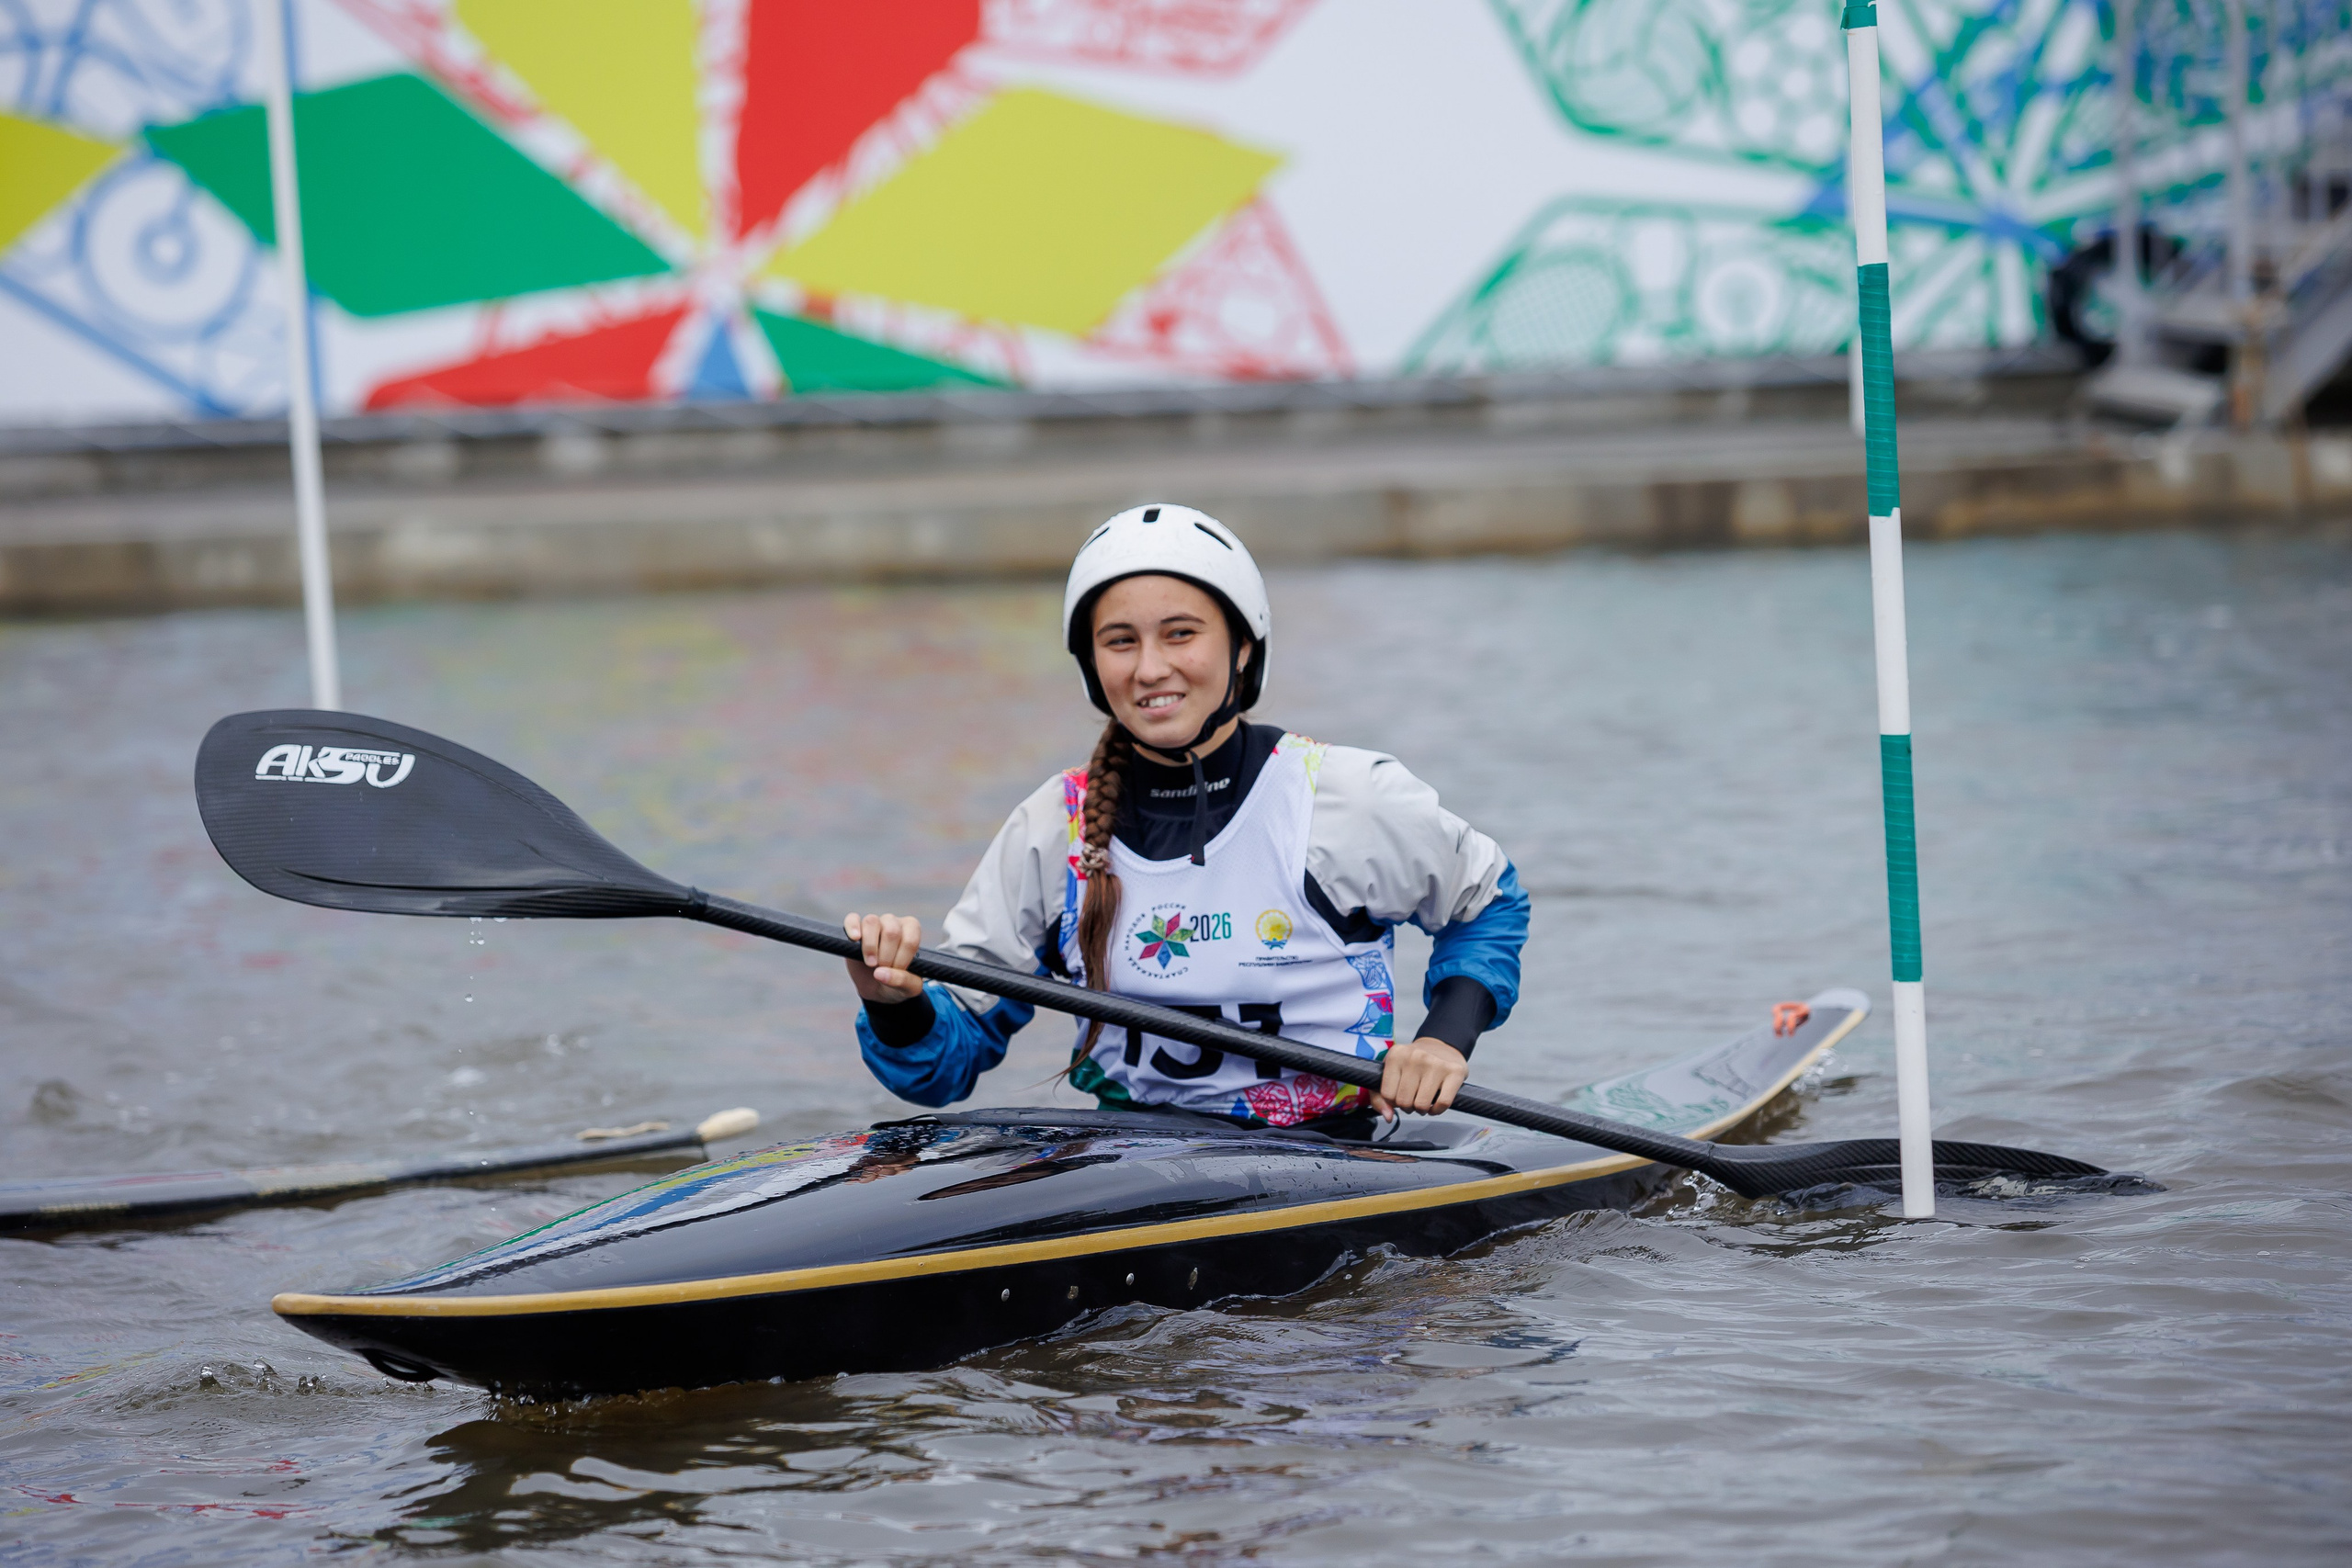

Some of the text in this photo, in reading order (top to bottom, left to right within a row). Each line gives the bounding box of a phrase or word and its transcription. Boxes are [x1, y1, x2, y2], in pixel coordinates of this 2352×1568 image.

[255, 744, 416, 789] AKSU
[345, 752, 401, 766] PADDLES
[1190, 912, 1232, 943] 2026
